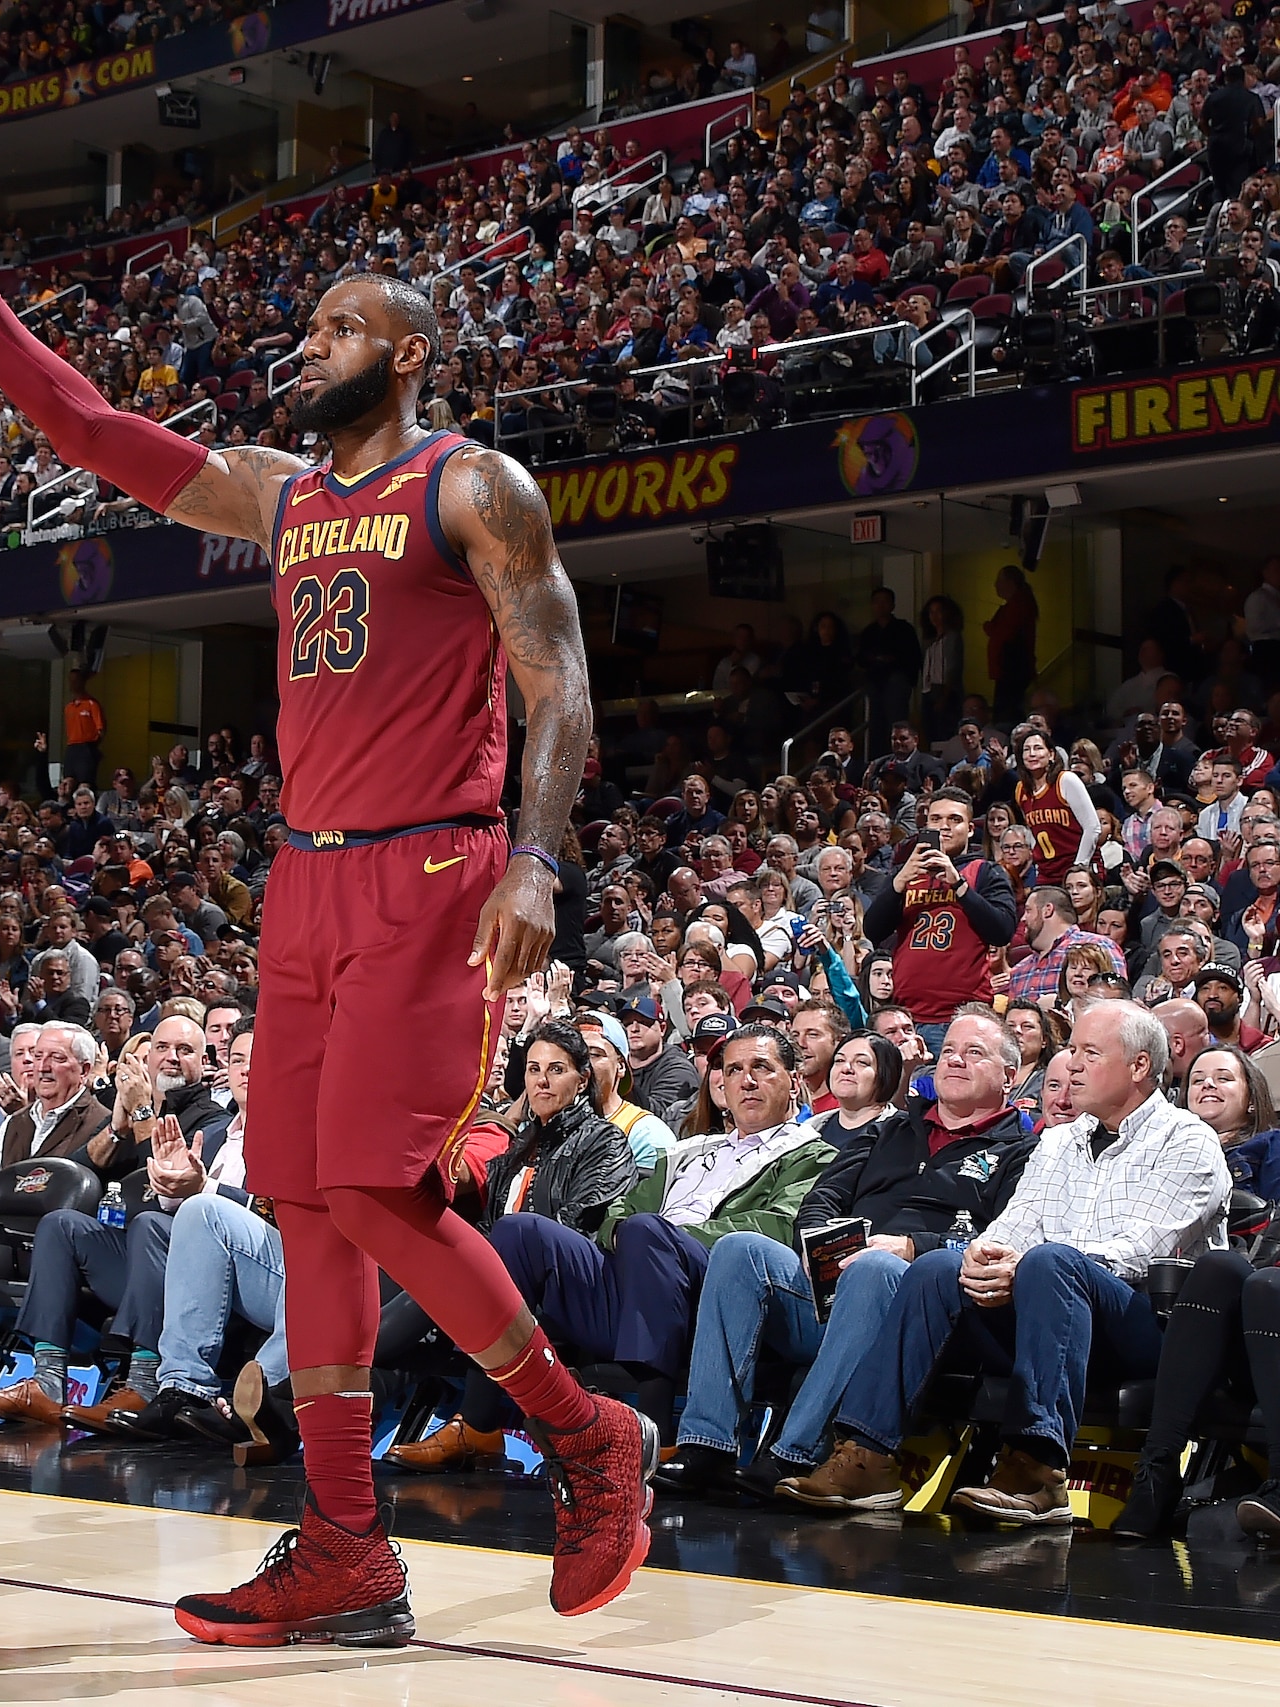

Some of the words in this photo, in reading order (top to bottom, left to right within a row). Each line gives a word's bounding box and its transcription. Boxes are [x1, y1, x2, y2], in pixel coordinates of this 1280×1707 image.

[95, 49, 154, 88] COM
[1077, 367, 1280, 446] FIREW
[540, 449, 735, 525] WORKS
[278, 514, 410, 577] CLEVELAND
[853, 518, 877, 541] EXIT
[289, 567, 370, 681] 23
[1037, 831, 1056, 859] 0
[910, 911, 956, 951] 23
